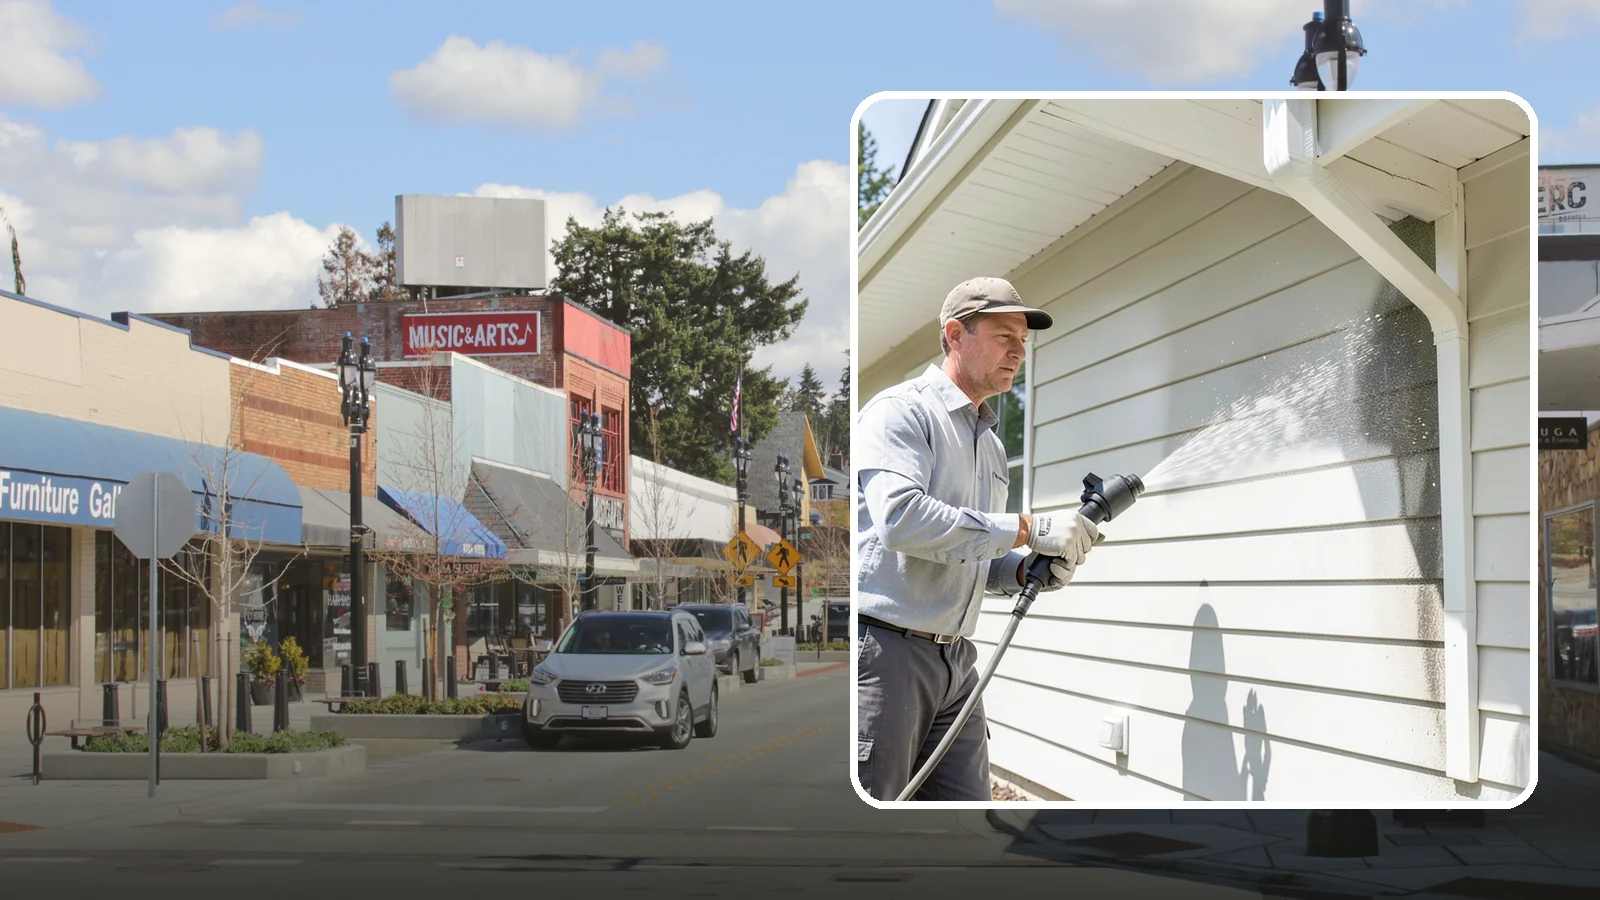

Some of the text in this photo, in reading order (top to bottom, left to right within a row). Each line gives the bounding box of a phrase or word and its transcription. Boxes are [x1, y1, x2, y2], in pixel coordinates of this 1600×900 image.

[0, 471, 121, 519] Furniture Gal
[453, 563, 479, 574] SUSHI
